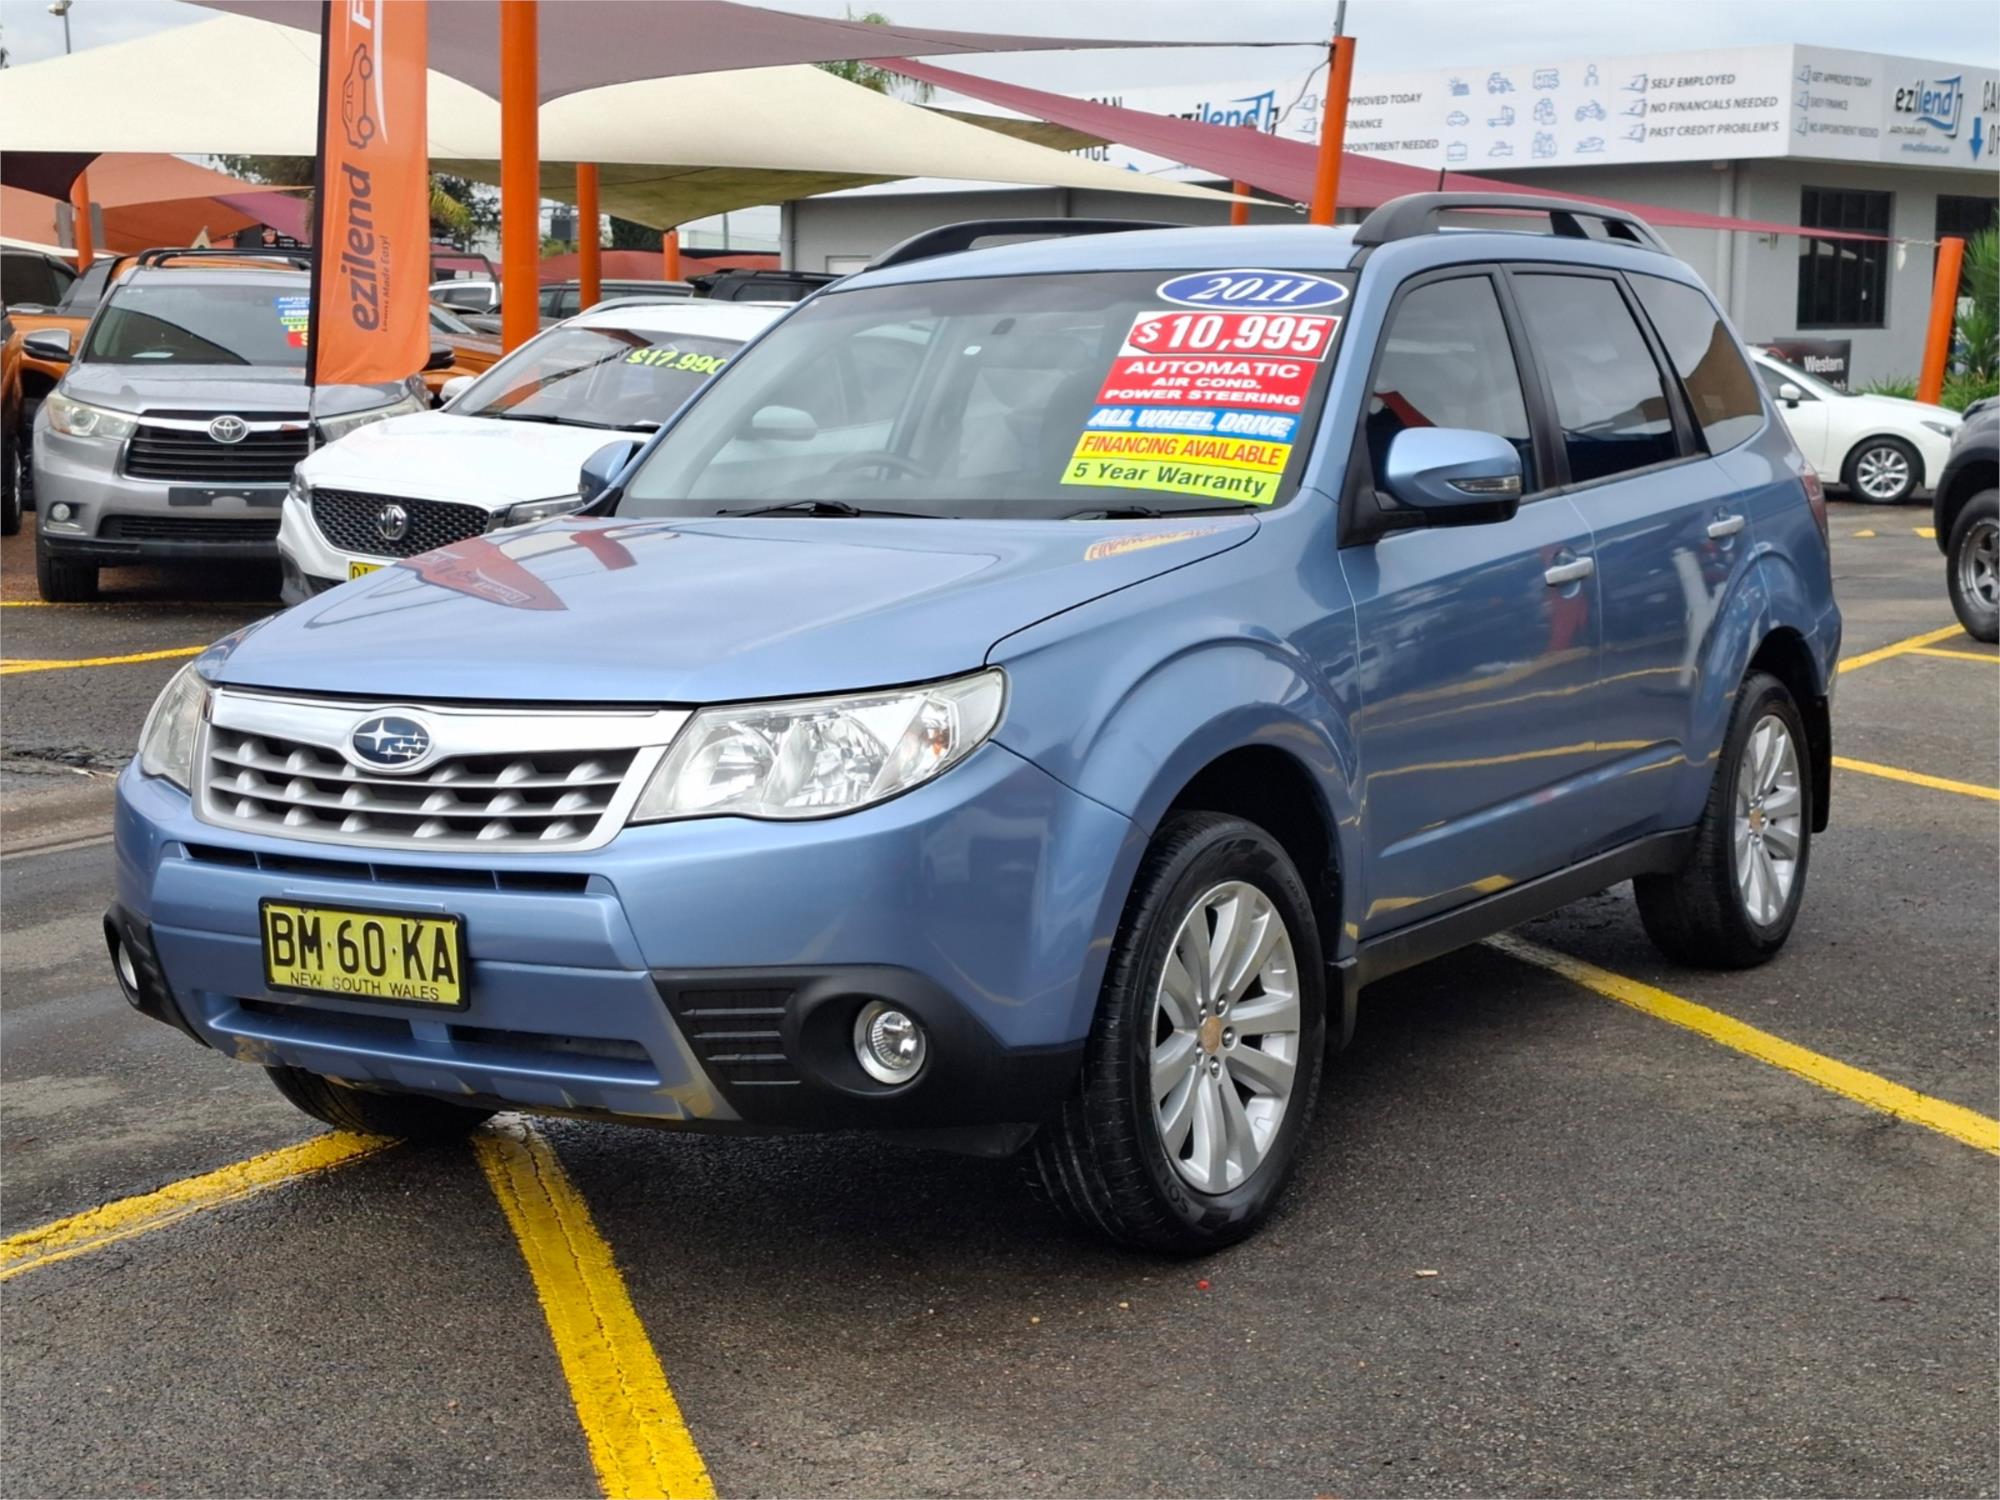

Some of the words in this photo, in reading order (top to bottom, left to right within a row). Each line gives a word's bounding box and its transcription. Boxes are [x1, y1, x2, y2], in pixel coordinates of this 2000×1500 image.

[1650, 78, 1675, 90] SELF
[1677, 74, 1736, 88] EMPLOYED
[1390, 93, 1423, 105] TODAY
[1650, 103, 1666, 113] NO
[1668, 98, 1731, 112] FINANCIALS
[1733, 96, 1778, 109] NEEDED
[1895, 79, 1953, 116] ezilend
[1649, 126, 1675, 138] PAST
[1676, 124, 1715, 136] CREDIT
[1715, 121, 1780, 135] PROBLEM'S
[1400, 139, 1439, 150] NEEDED
[340, 161, 379, 331] ezilend
[1186, 277, 1319, 302] 2011
[1124, 361, 1302, 379] AUTOMATIC
[1803, 355, 1844, 373] Western
[1151, 377, 1189, 387] AIR
[1195, 378, 1262, 389] COND.
[1104, 389, 1182, 400] POWER
[1187, 390, 1300, 406] STEERING
[1087, 408, 1134, 427] ALL
[1135, 409, 1216, 430] WHEEL
[1216, 412, 1295, 437] DRIVE
[1081, 436, 1179, 455] FINANCING
[1180, 440, 1283, 466] AVAILABLE
[1073, 462, 1090, 478] 5
[1098, 463, 1149, 481] Year
[1157, 466, 1267, 497] Warranty
[290, 971, 322, 986] NEW
[332, 977, 381, 995] SOUTH
[389, 983, 439, 1001] WALES
